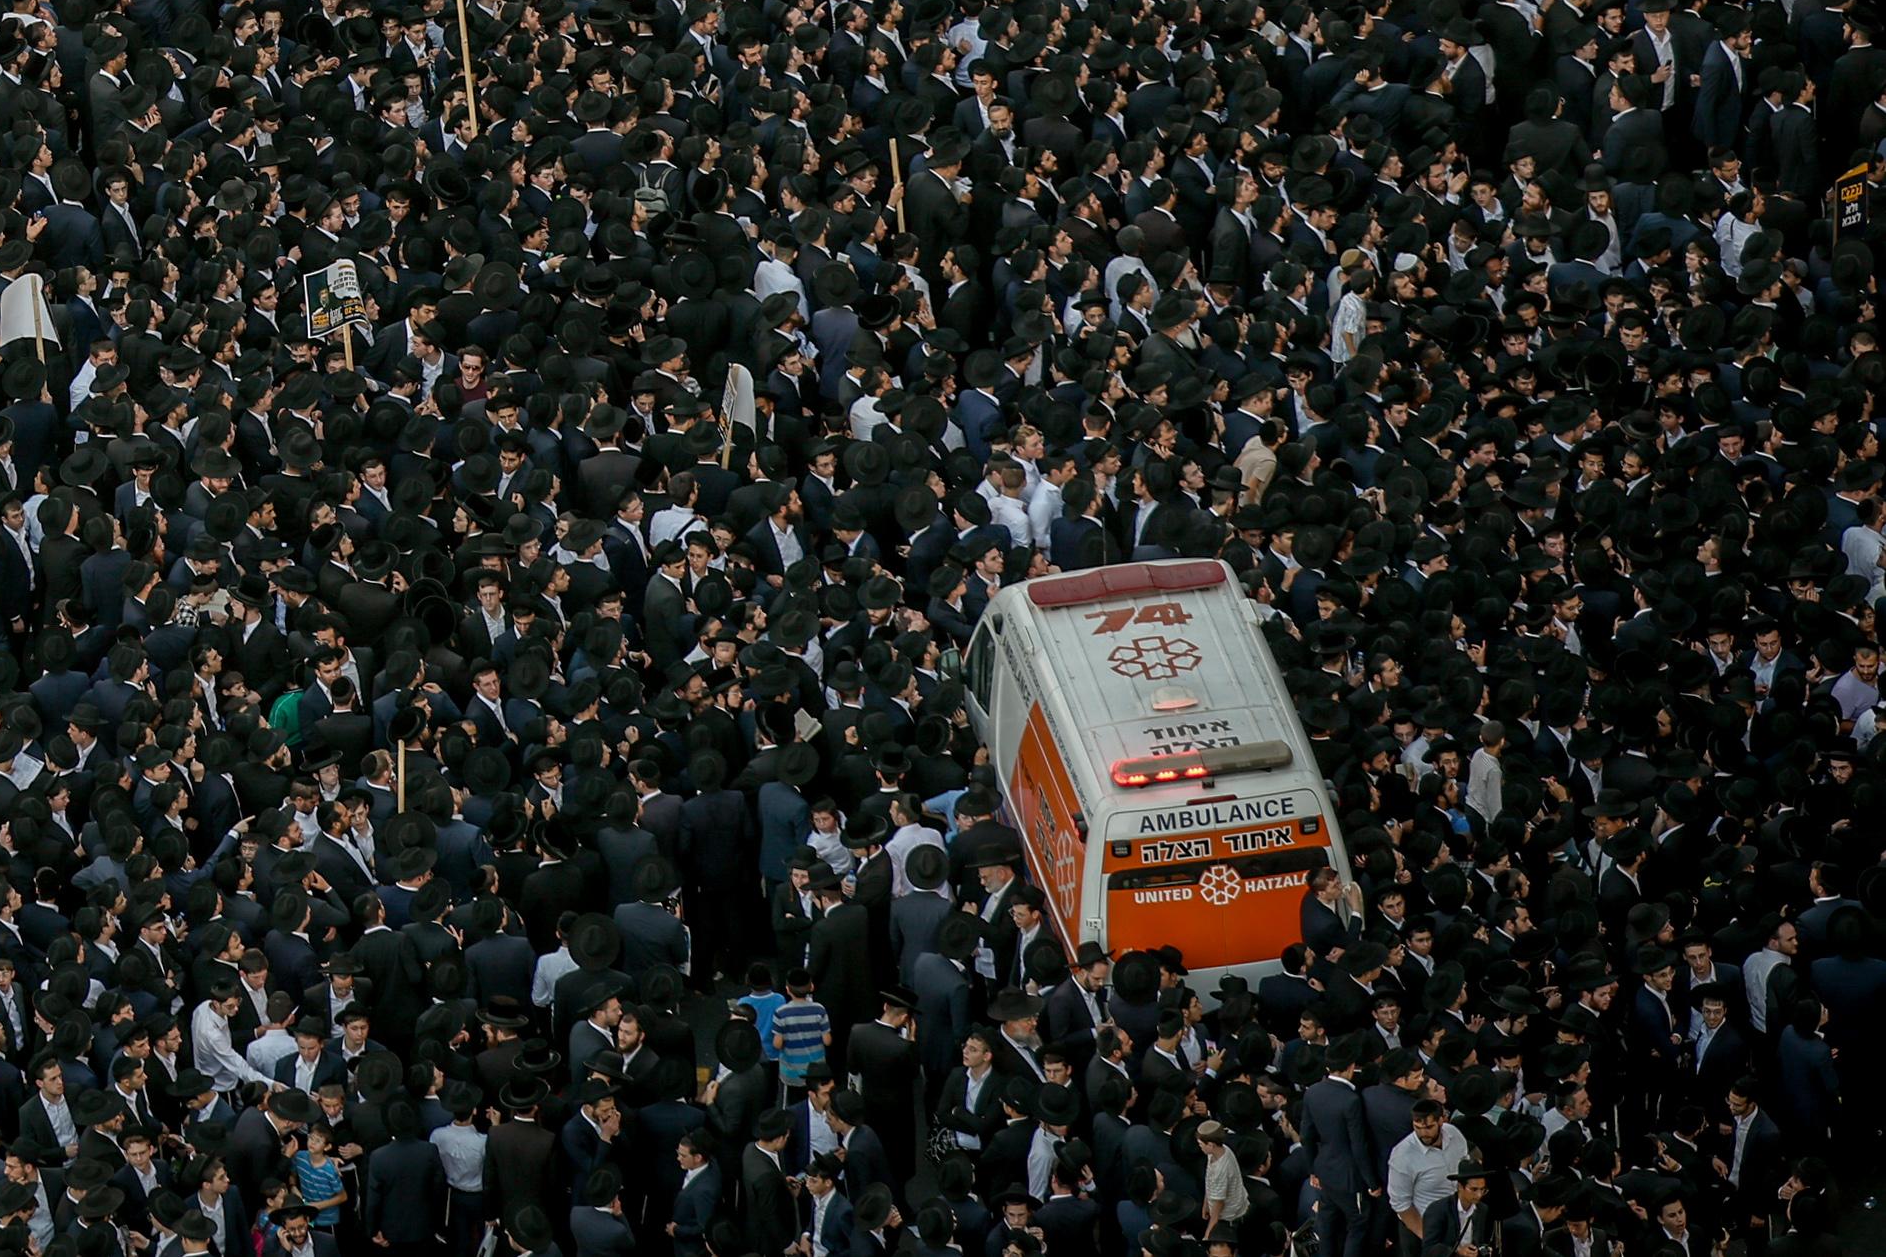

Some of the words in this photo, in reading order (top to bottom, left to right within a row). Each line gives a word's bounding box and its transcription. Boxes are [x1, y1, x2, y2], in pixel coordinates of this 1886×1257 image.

[1842, 183, 1862, 199] לכלא
[1845, 202, 1858, 215] ולא
[1841, 212, 1862, 228] לצבא
[1084, 603, 1193, 635] 74
[1143, 719, 1233, 740] איחוד
[1149, 736, 1240, 756] הצלה
[1140, 797, 1295, 833] AMBULANCE
[1142, 839, 1210, 863] הצלה
[1224, 827, 1293, 853] איחוד
[1134, 887, 1193, 904] UNITED
[1245, 872, 1309, 893] HATZALA
